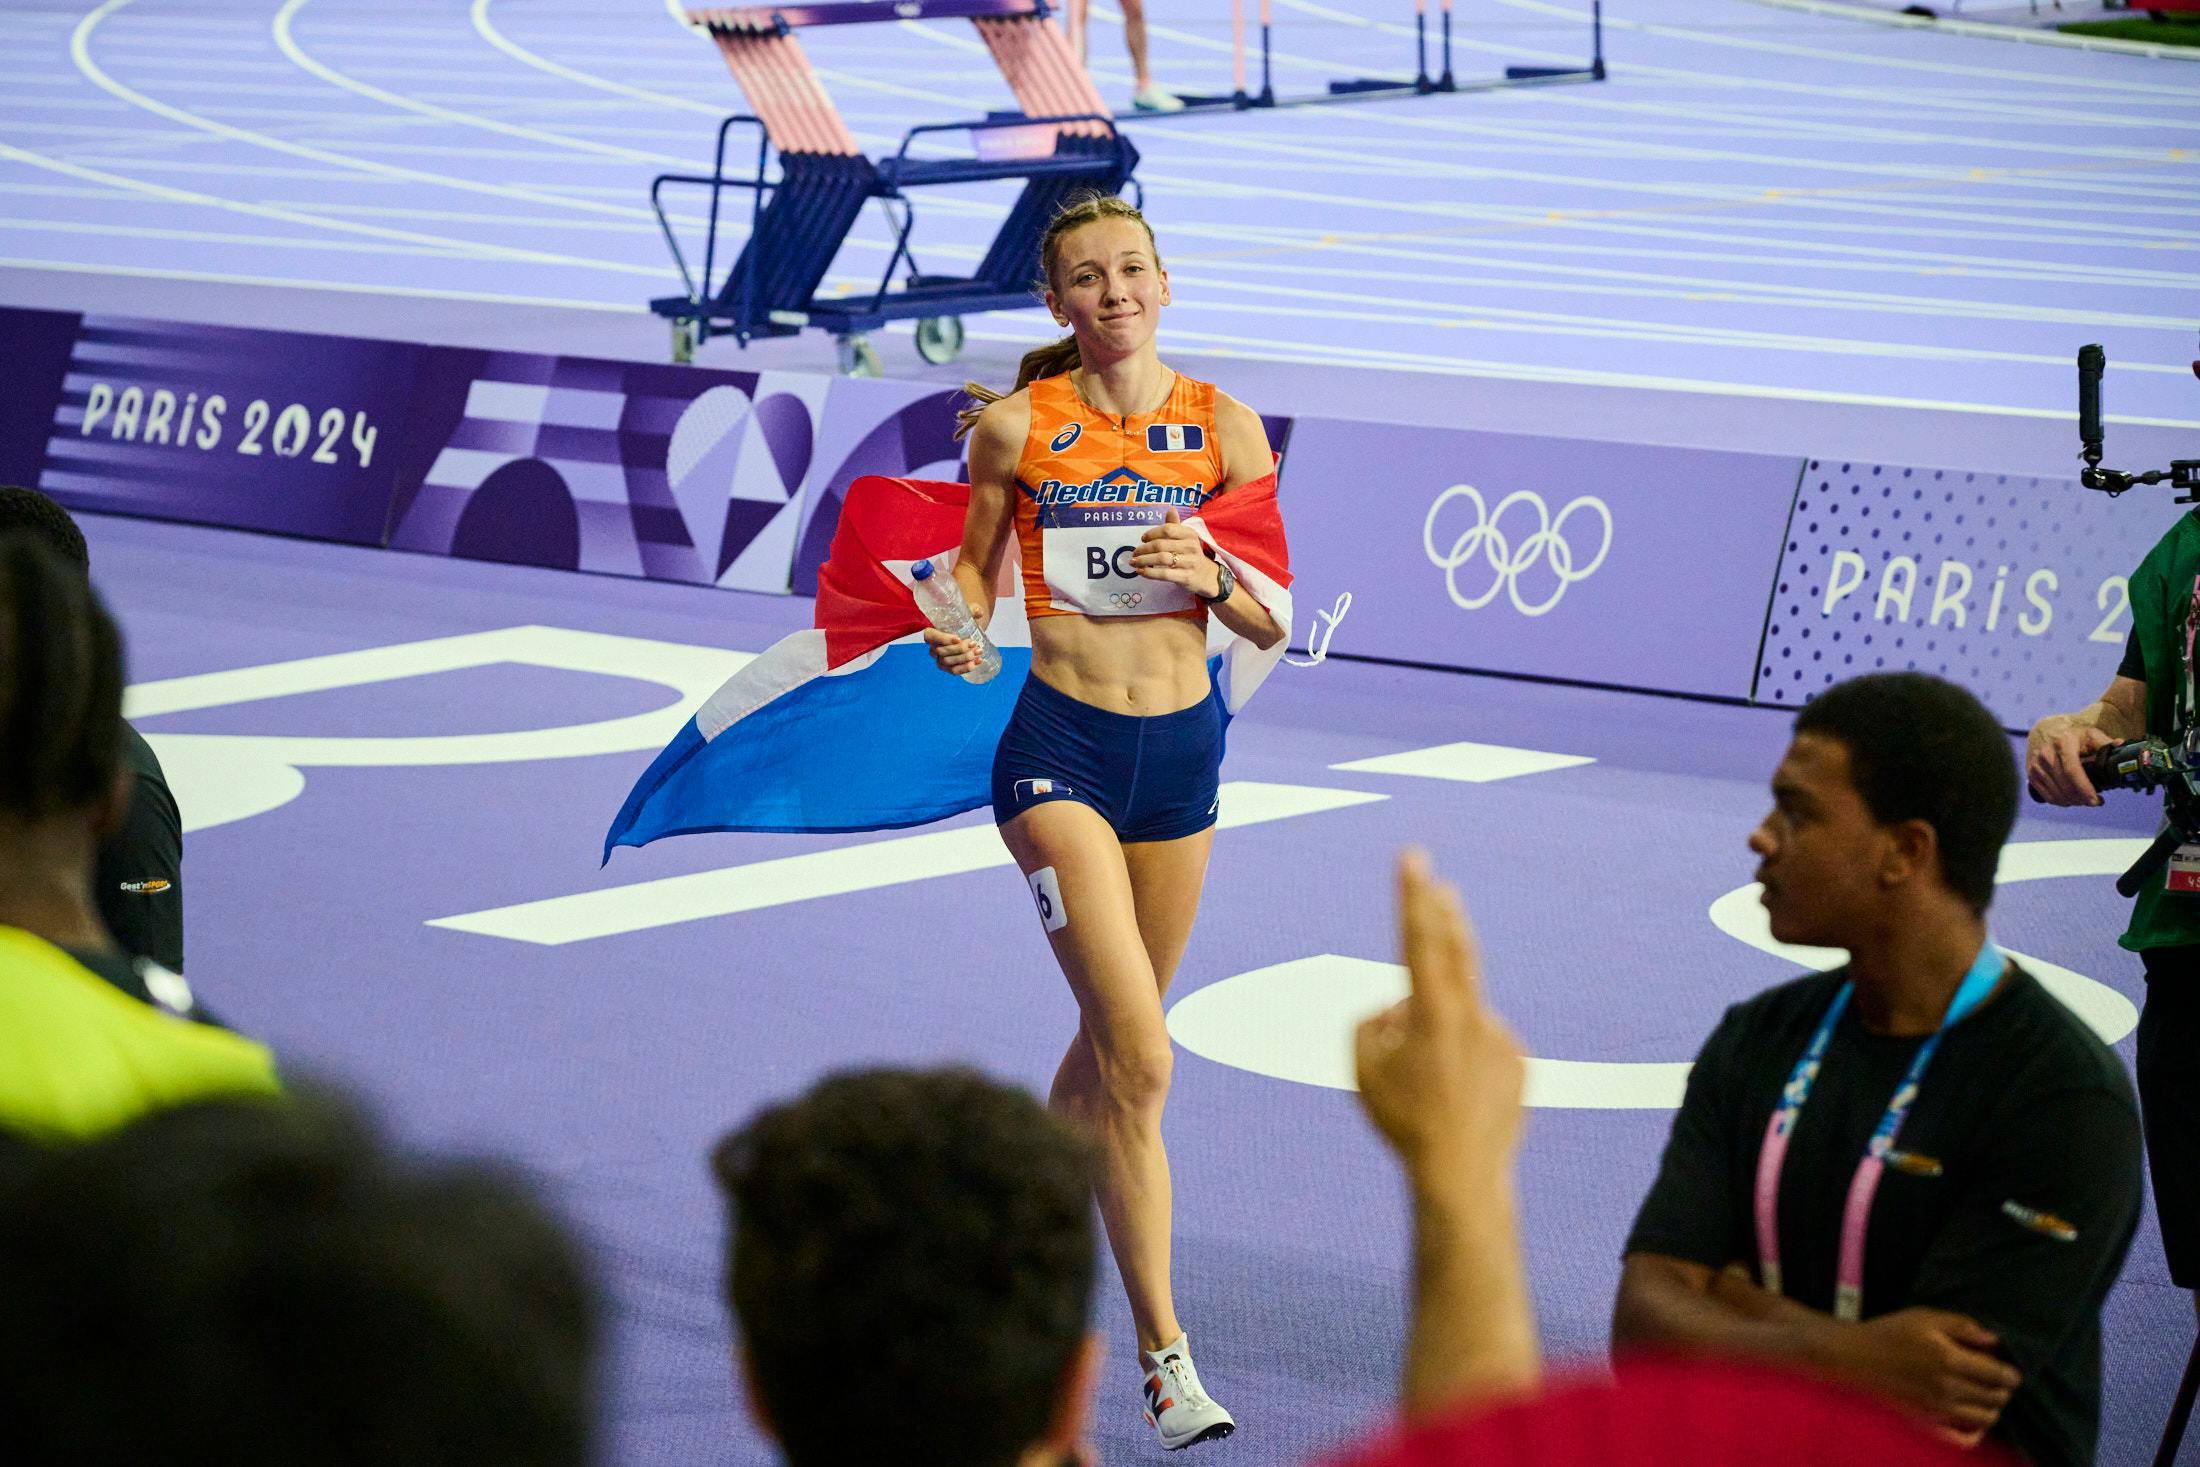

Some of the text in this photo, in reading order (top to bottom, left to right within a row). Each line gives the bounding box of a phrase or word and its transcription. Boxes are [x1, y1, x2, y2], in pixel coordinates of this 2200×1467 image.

[237, 400, 378, 468] 2024
[1127, 510, 1163, 520] 2024
[1037, 883, 1052, 920] 6
